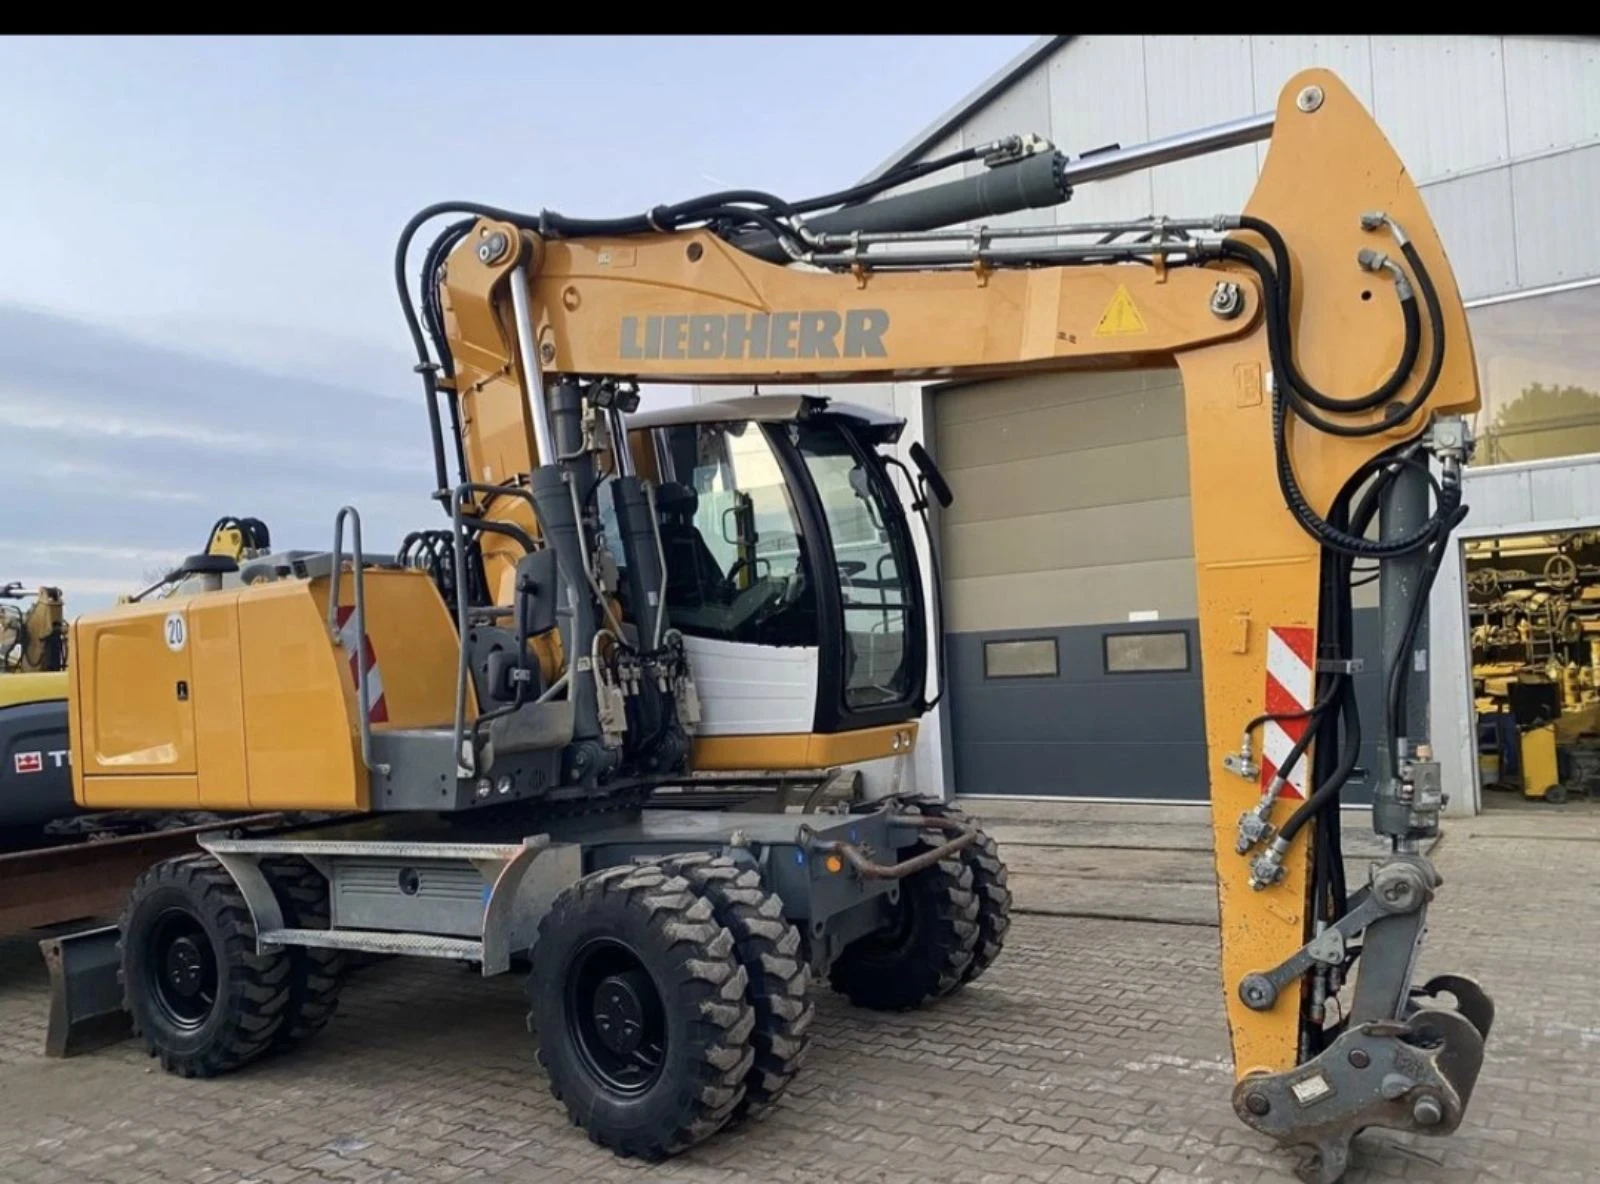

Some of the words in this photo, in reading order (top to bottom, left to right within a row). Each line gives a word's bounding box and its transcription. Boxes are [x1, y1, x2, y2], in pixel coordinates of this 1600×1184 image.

[619, 309, 890, 359] LIEBHERR
[168, 619, 183, 644] 20
[48, 750, 72, 767] T
